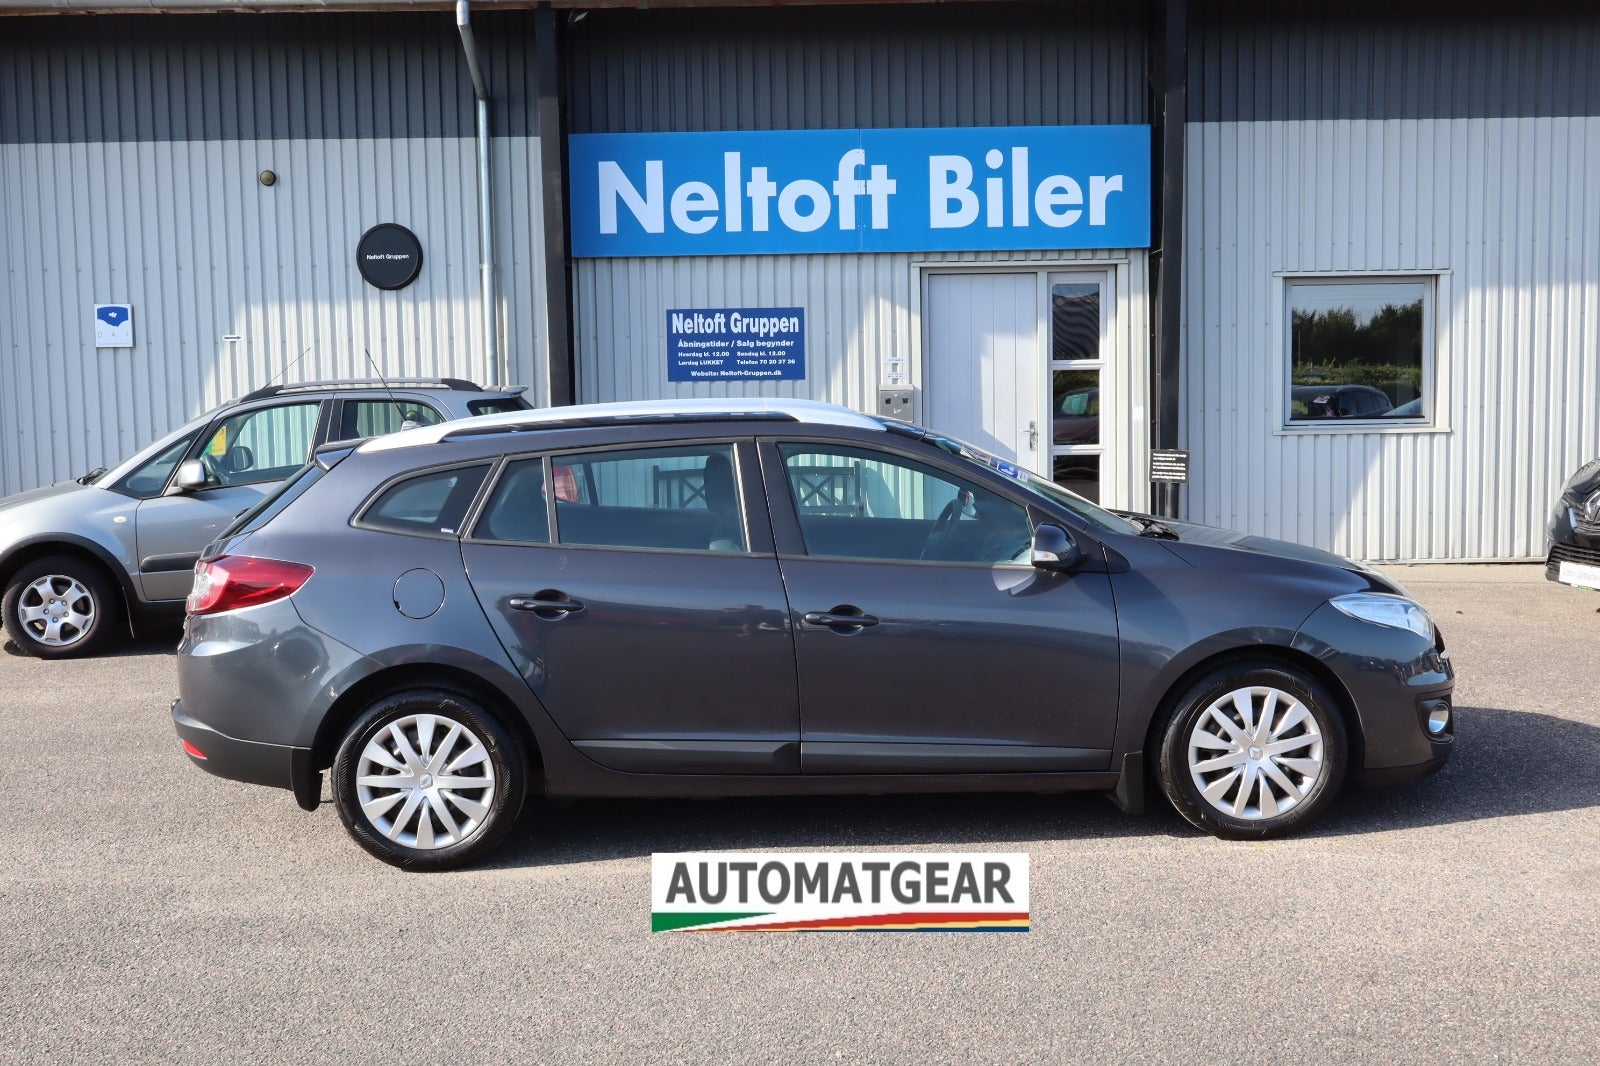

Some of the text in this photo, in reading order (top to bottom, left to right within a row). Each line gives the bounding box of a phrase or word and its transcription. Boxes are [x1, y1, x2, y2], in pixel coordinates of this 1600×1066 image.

[597, 146, 1124, 235] Neltoft Biler
[385, 253, 410, 261] Gruppen
[672, 311, 799, 338] Neltoft Gruppen
[677, 338, 730, 349] Åbningstider
[736, 339, 755, 348] Salg
[756, 339, 795, 348] begynder
